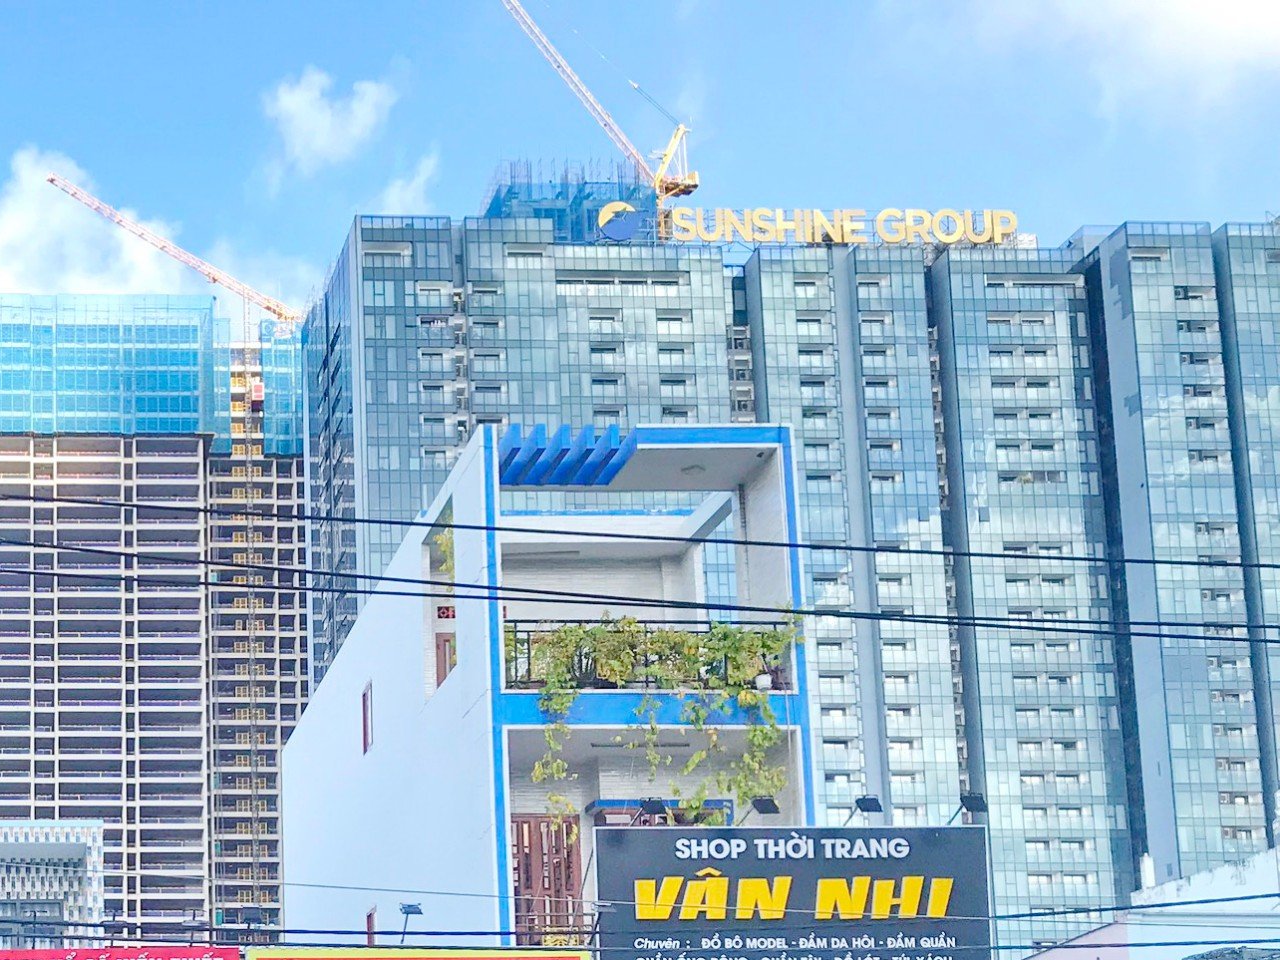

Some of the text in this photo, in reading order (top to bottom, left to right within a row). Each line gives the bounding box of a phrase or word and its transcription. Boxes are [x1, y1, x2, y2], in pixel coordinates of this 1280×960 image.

[672, 207, 1017, 244] SUNSHINE GROUP
[675, 831, 910, 859] SHOP THỜI TRANG
[634, 867, 954, 920] VÂN NHI
[746, 938, 788, 949] MODEL
